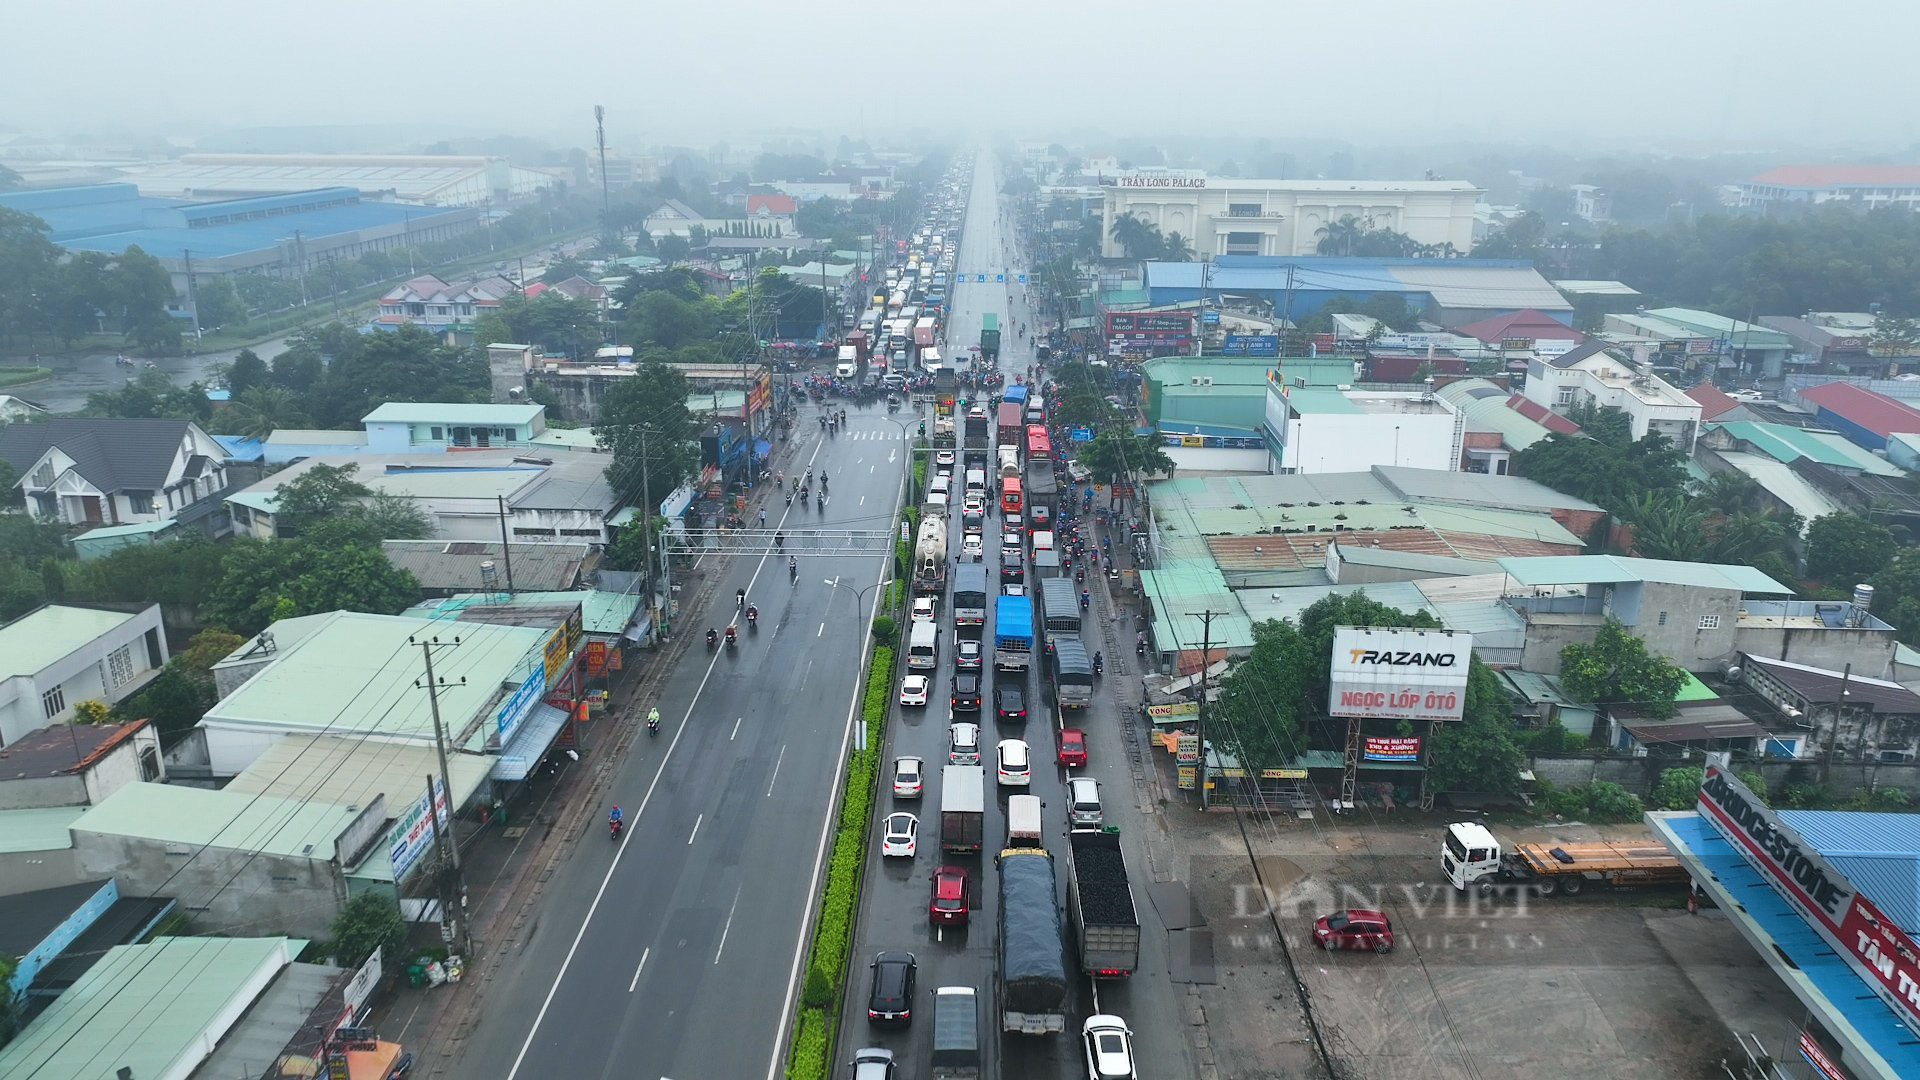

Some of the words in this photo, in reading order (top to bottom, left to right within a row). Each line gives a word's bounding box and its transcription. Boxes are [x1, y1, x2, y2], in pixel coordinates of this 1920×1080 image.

[1147, 178, 1170, 187] LONG
[1172, 178, 1206, 188] PALACE
[1350, 649, 1456, 667] TRAZANO
[1340, 692, 1385, 710] NGỌC
[1389, 688, 1420, 709] LỐP
[1424, 691, 1457, 710] ÔTÔ
[1150, 706, 1171, 715] VÕNG
[1702, 765, 1849, 914] BRIDGESTONE
[1856, 929, 1895, 980] TÂN
